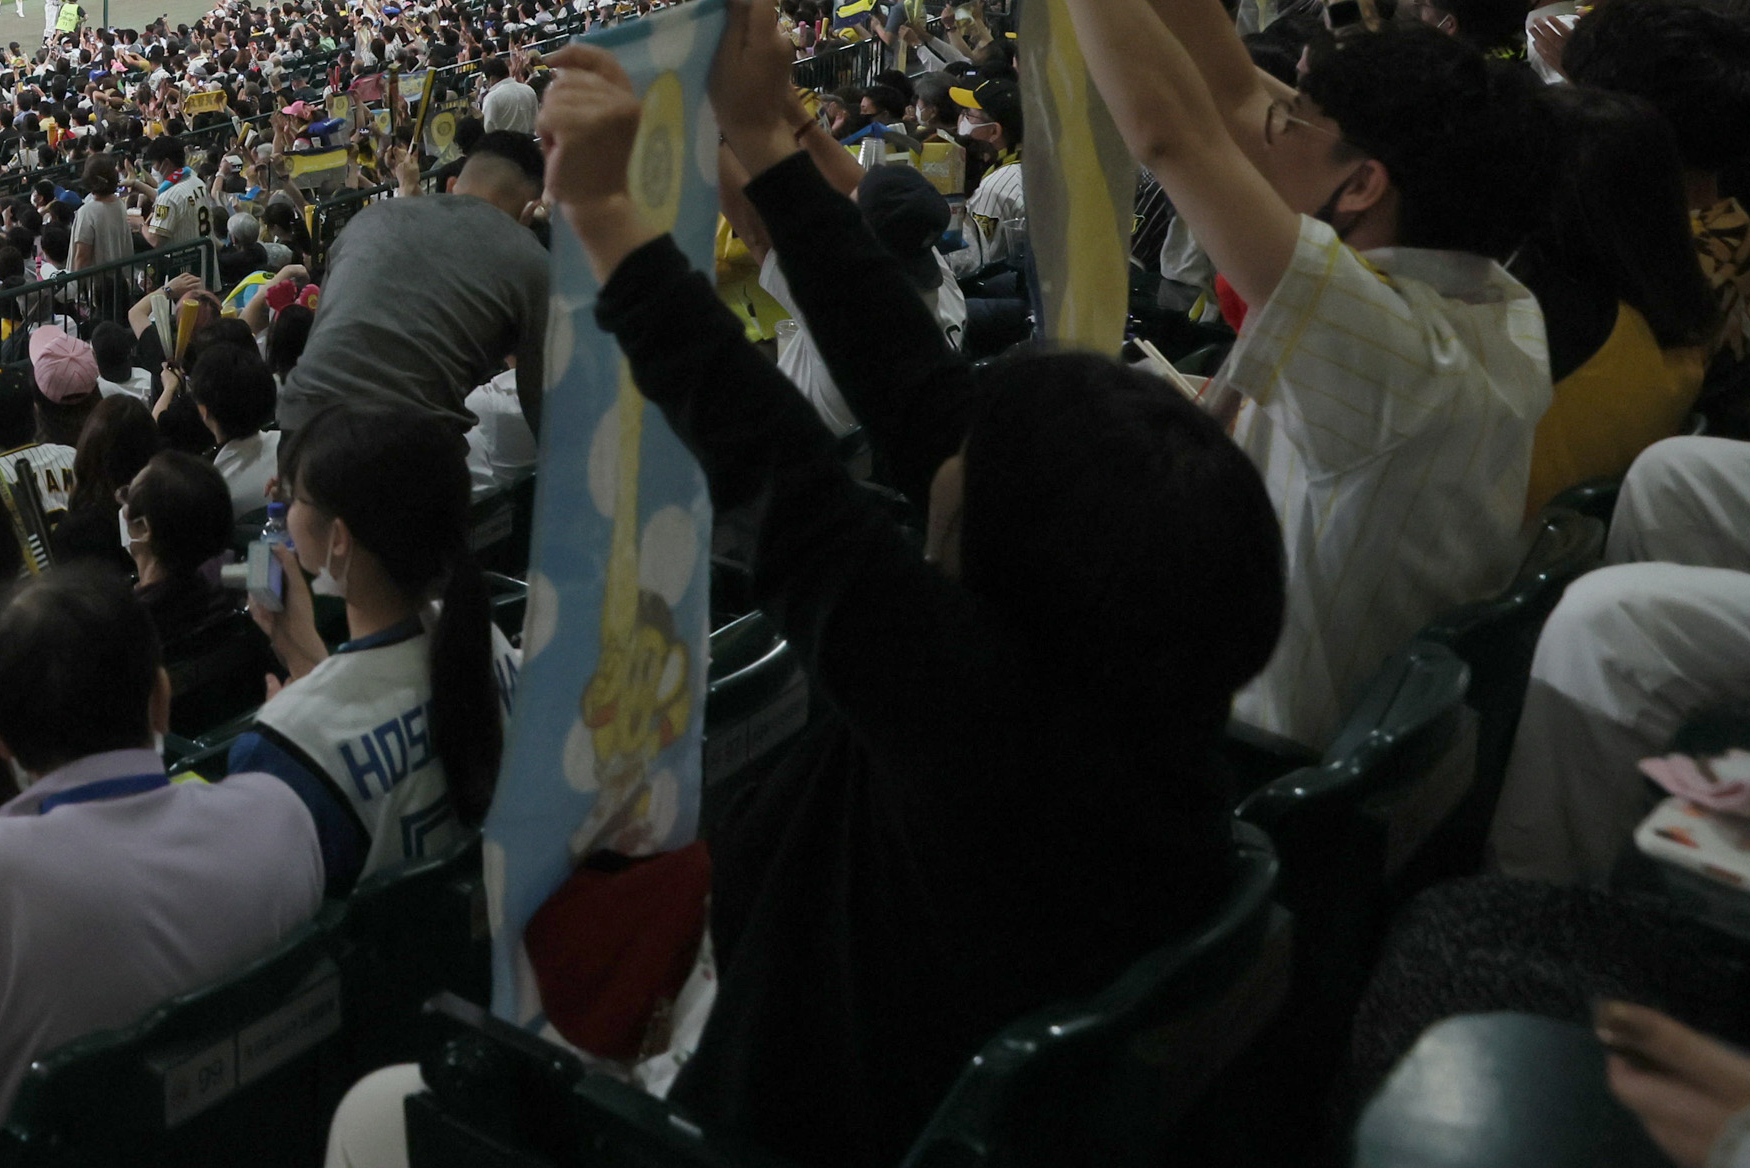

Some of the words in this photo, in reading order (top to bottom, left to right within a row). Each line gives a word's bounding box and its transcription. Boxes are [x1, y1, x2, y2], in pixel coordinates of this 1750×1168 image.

[188, 186, 205, 207] SAT
[198, 206, 211, 236] 8
[339, 699, 437, 801] HOS
